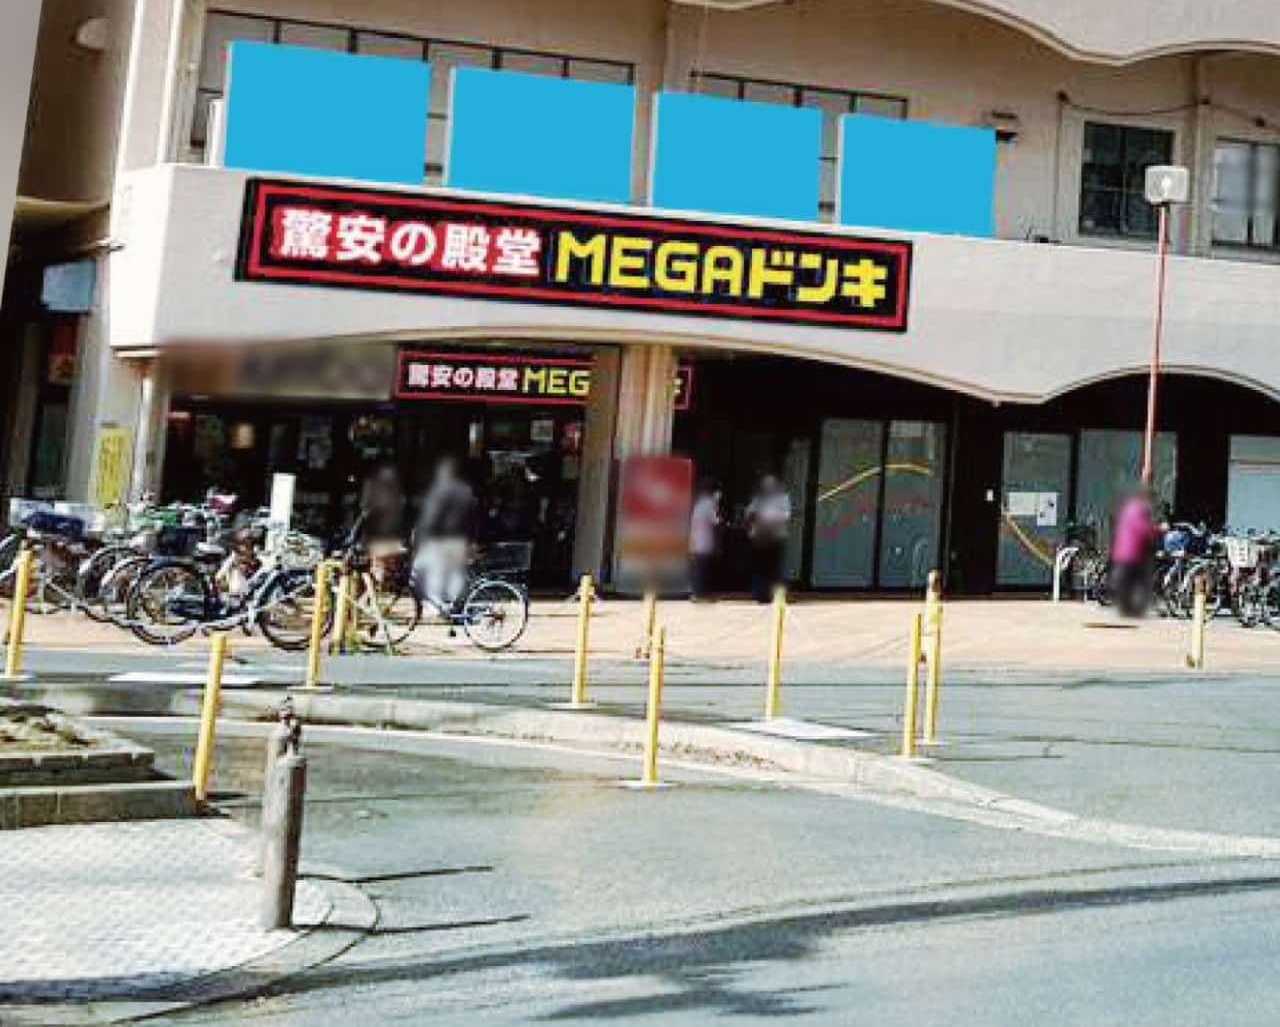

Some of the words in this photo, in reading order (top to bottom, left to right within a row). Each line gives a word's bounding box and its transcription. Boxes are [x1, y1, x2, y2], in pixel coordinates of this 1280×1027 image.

[277, 206, 541, 275] 驚安の殿堂
[555, 231, 888, 308] MEGAドンキ
